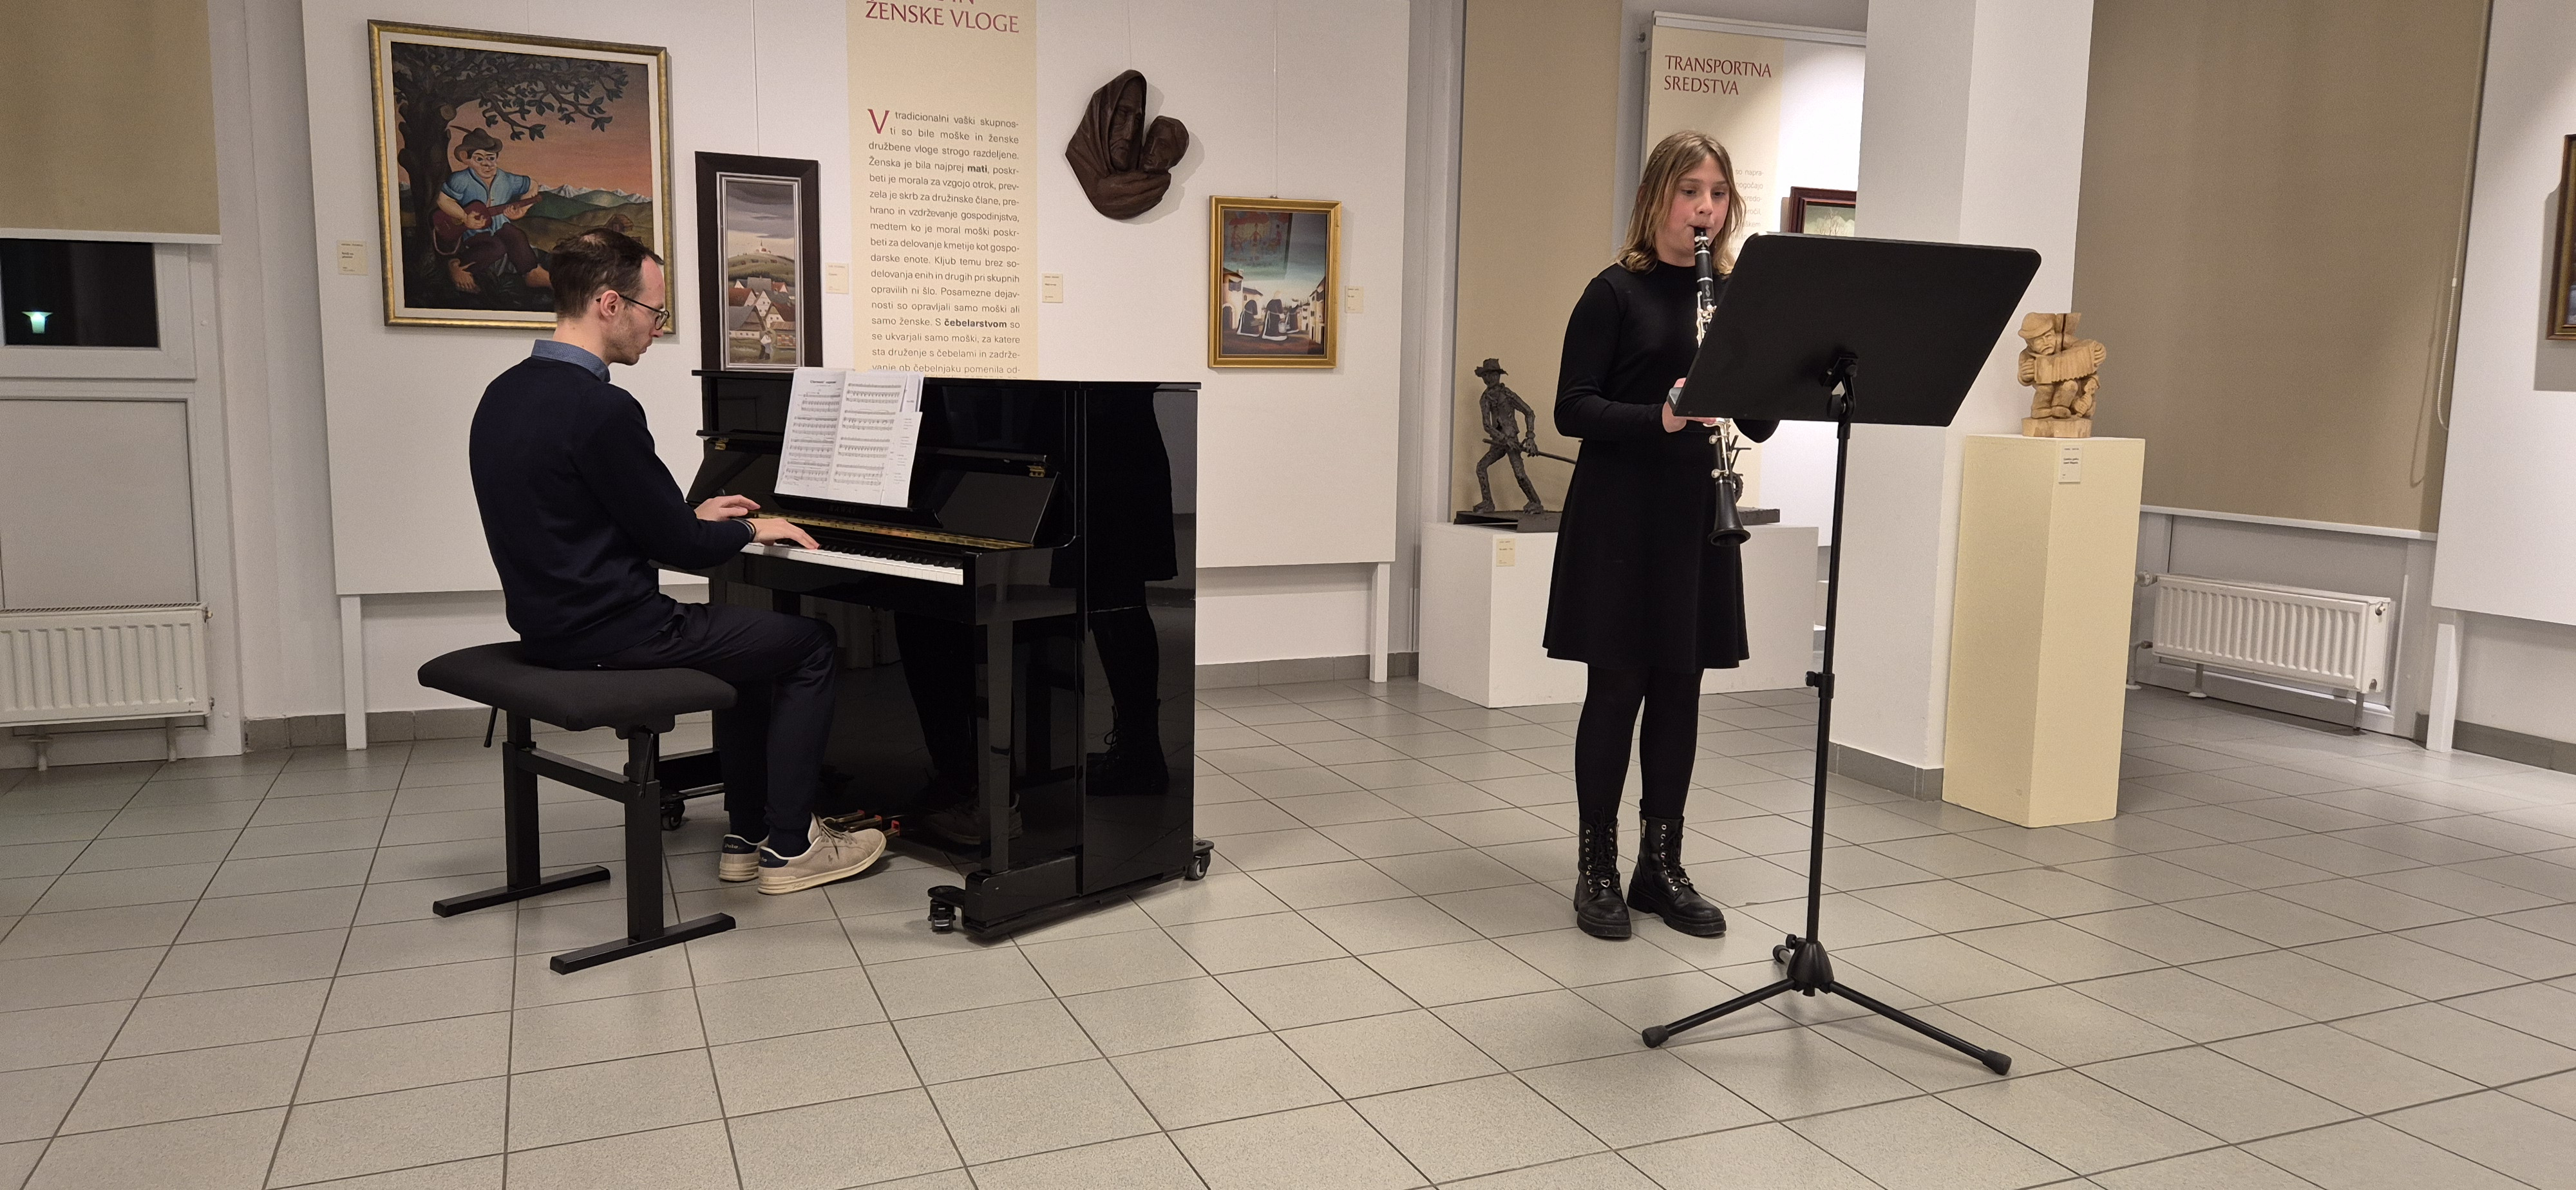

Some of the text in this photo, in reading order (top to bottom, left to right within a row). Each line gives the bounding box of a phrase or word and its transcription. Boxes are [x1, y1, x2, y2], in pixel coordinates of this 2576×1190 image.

[949, 9, 1019, 33] VLOGE
[1664, 55, 1772, 78] TRANSPORTNA
[1663, 75, 1739, 95] SREDSTVA
[867, 108, 1019, 134] V tradicionalni vaški skupnos-
[889, 126, 896, 135] ti
[918, 128, 935, 138] bile
[940, 131, 971, 141] moške
[974, 133, 983, 142] in
[988, 133, 1019, 144] ženske
[868, 140, 1019, 160] družbene vloge strogo razdeljene.
[868, 155, 1019, 176] Ženska je bila najprej mati, poskr-
[869, 173, 886, 183] beti
[887, 175, 896, 185] je
[898, 176, 929, 185] morala
[942, 178, 971, 190] vzgojo
[972, 180, 996, 191] otrok,
[998, 182, 1019, 192] prev-
[869, 189, 887, 199] zela
[888, 191, 898, 201] je
[899, 191, 919, 201] skrb
[931, 193, 974, 204] družinske
[975, 195, 1001, 207] člane,
[1002, 198, 1019, 207] pre-
[869, 205, 1020, 223] hrano in vzdrževanje gospodinjstva,
[870, 221, 1019, 238] medtem ko je moral moški poskr-
[870, 237, 887, 247] beti
[900, 238, 942, 250] delovanje
[943, 240, 975, 252] kmetije
[976, 242, 989, 252] kot
[990, 244, 1020, 254] gospo-
[870, 253, 900, 263] darske
[903, 256, 931, 264] enote.
[934, 256, 956, 267] Kljub
[959, 258, 981, 267] temu
[985, 258, 1004, 267] brez
[870, 269, 1020, 285] delovanja enih in drugih pri skupnih
[871, 285, 1020, 300] opravilih ni šlo. Posamezne dejav-
[871, 301, 894, 310] nosti
[911, 302, 951, 313] opravljali
[981, 304, 1007, 314] moški
[1010, 305, 1020, 314] ali
[899, 317, 933, 326] ženske.
[934, 317, 942, 326] S
[943, 317, 1007, 328] čebelarstvom
[885, 332, 922, 343] ukvarjali
[951, 334, 980, 344] moški,
[994, 335, 1021, 344] katere
[872, 348, 886, 356] sta
[887, 347, 927, 359] druženje
[936, 348, 977, 358] čebelami
[979, 350, 987, 358] in
[989, 350, 1020, 359] zadrže-
[898, 363, 911, 372] ob
[913, 363, 961, 374] čebelnjaku
[964, 365, 1004, 374] pomenila
[1006, 366, 1020, 374] od-
